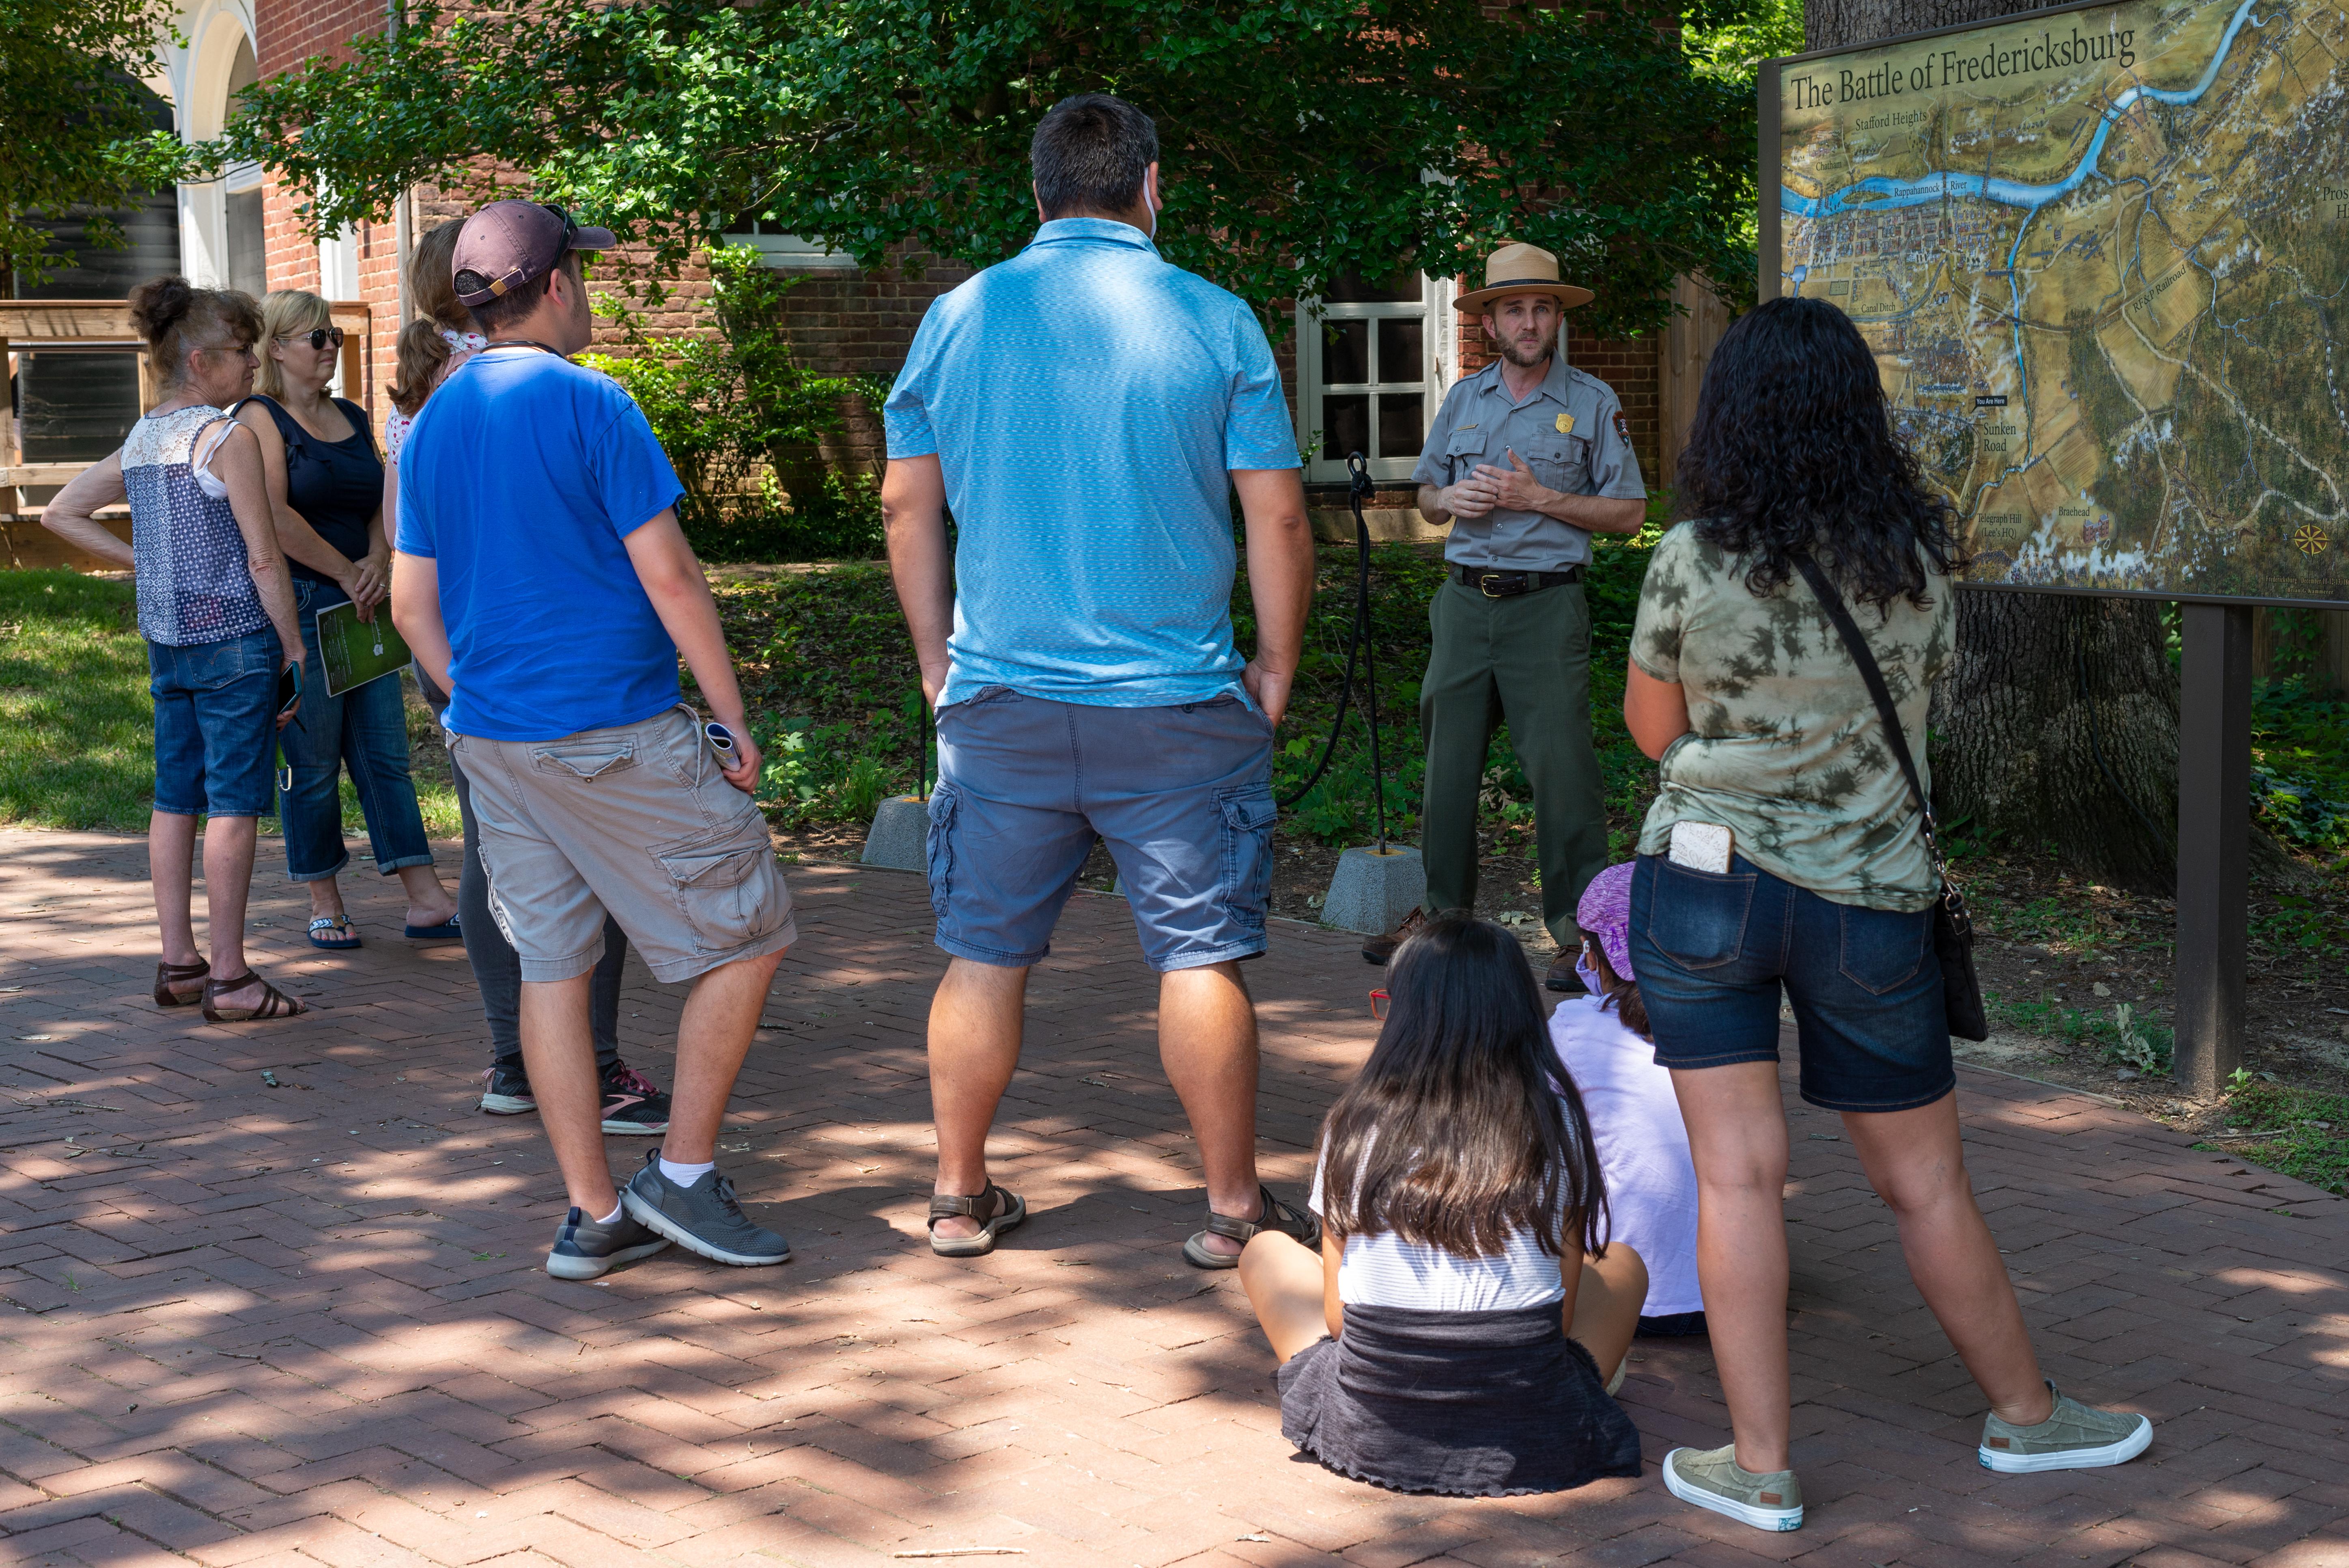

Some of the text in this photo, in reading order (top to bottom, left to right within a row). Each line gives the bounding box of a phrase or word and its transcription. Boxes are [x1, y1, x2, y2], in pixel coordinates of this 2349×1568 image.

[1791, 28, 2135, 110] The Battle of Fredericksburg
[1856, 110, 1927, 131] Stafford Heights
[1816, 161, 1842, 171] Chatham
[1894, 180, 1967, 199] Rappahannock River
[2133, 265, 2186, 313] RF&P Railroad
[1862, 302, 1895, 313] Canal Ditch
[1983, 423, 2016, 435] Sunken
[1984, 439, 2006, 451] Road
[2059, 506, 2090, 517] Braehead
[1978, 513, 2022, 525] Telegraph Hill
[2002, 528, 2016, 539] HQ)
[2266, 575, 2297, 584] Fredericksburg
